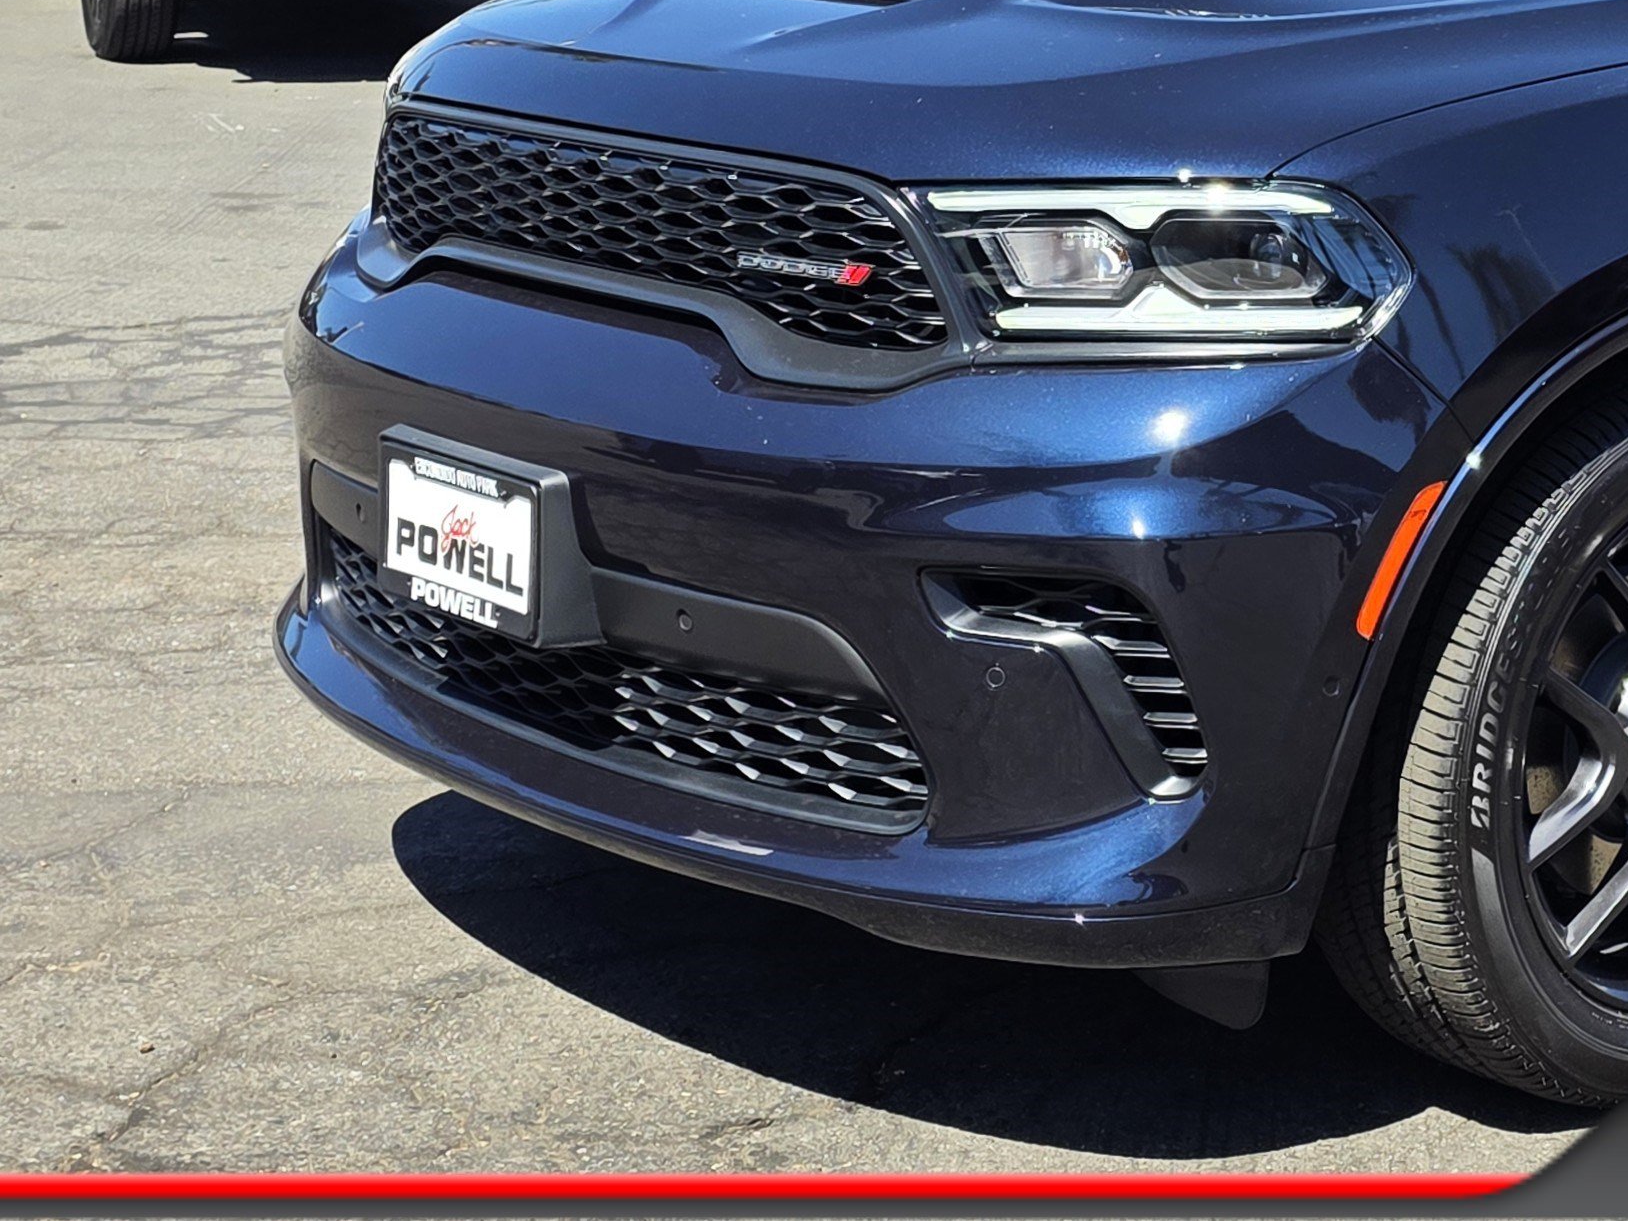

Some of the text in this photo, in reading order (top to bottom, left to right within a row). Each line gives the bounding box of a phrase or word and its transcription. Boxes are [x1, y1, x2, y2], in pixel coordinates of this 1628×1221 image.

[737, 252, 851, 279] DODGE
[441, 504, 479, 553] Jack
[396, 517, 524, 597] POWELL
[410, 576, 498, 629] POWELL
